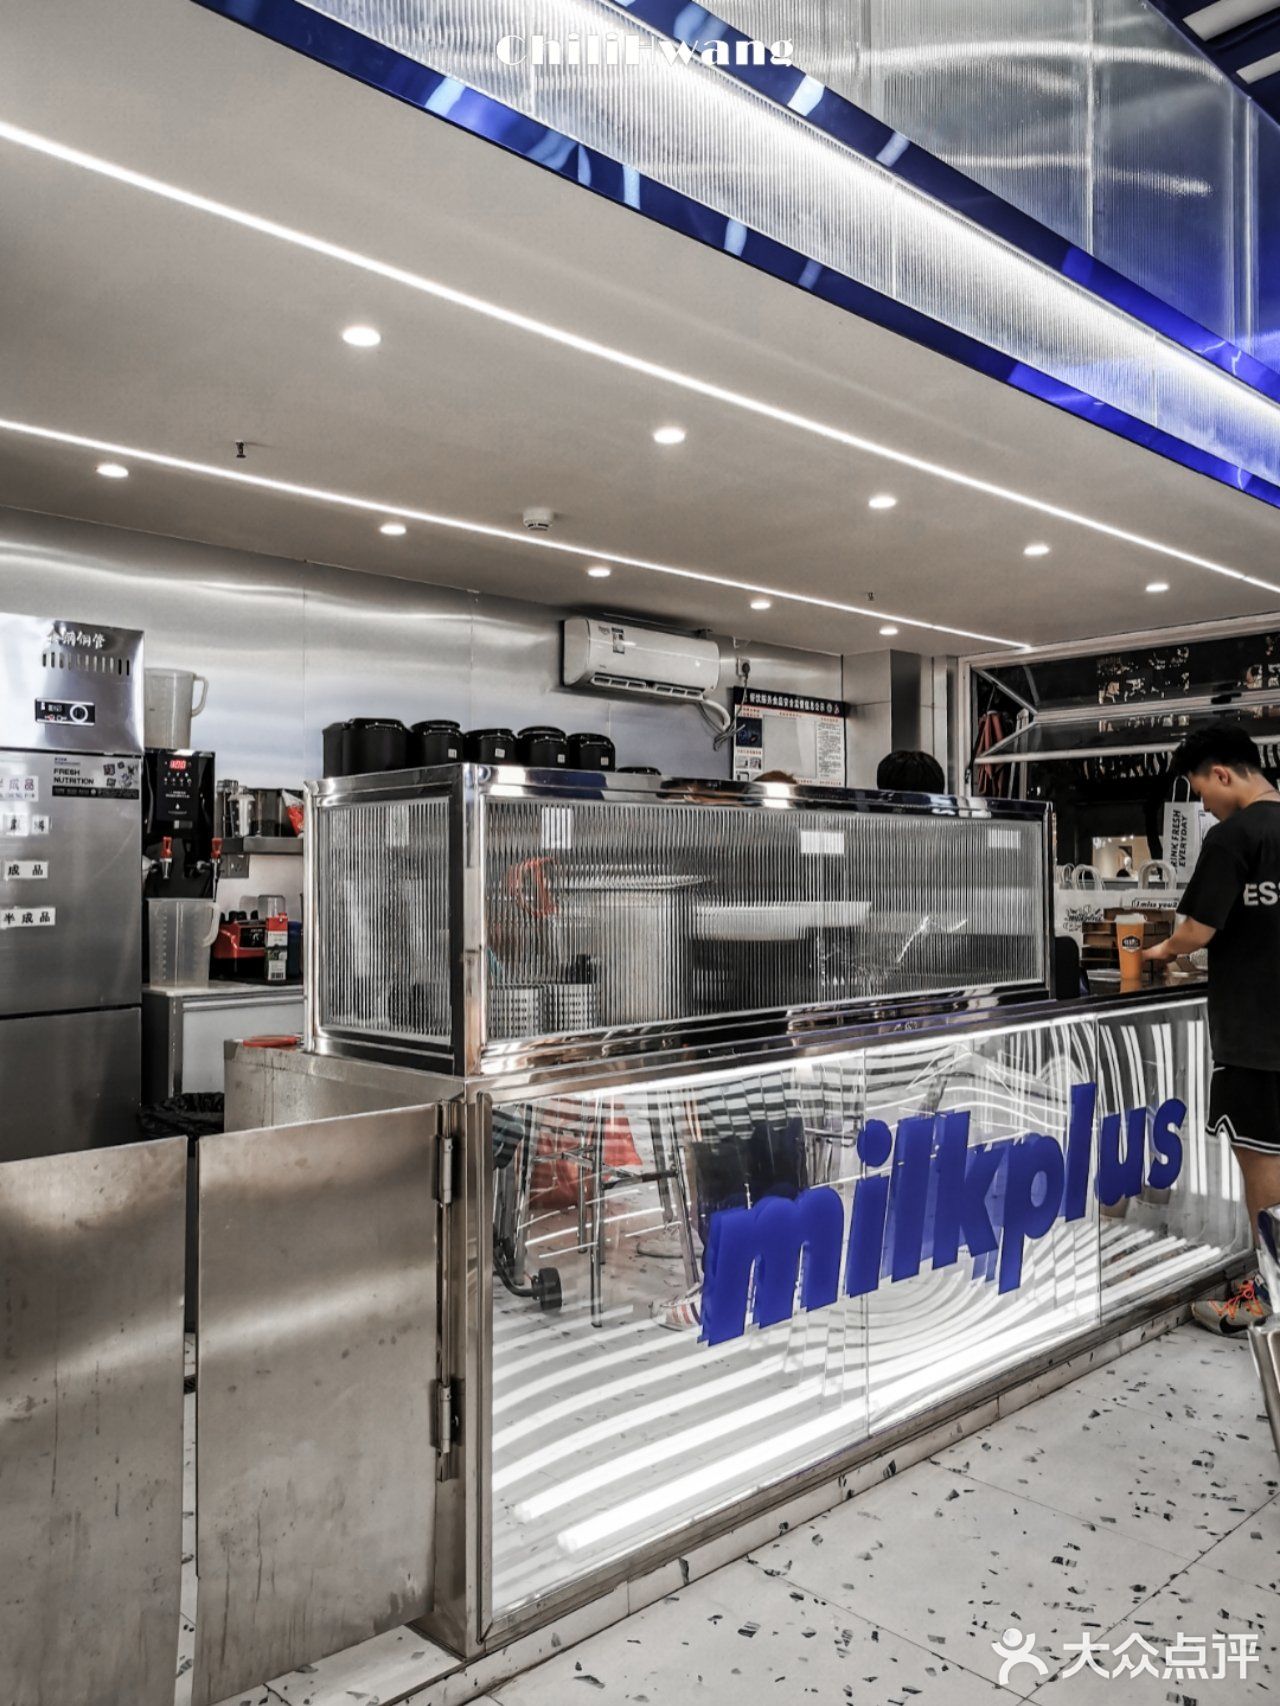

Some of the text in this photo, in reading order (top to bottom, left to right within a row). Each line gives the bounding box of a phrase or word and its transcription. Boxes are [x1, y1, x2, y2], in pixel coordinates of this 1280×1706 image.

[53, 767, 80, 776] FRESH
[53, 776, 95, 785] NUTRITION
[1171, 809, 1181, 841] FRESH
[1178, 814, 1188, 868] EVERYDAY
[8, 864, 43, 876] 成品
[1243, 881, 1280, 906] ES
[3, 911, 51, 925] 半成品
[702, 1082, 1187, 1346] milkplus
